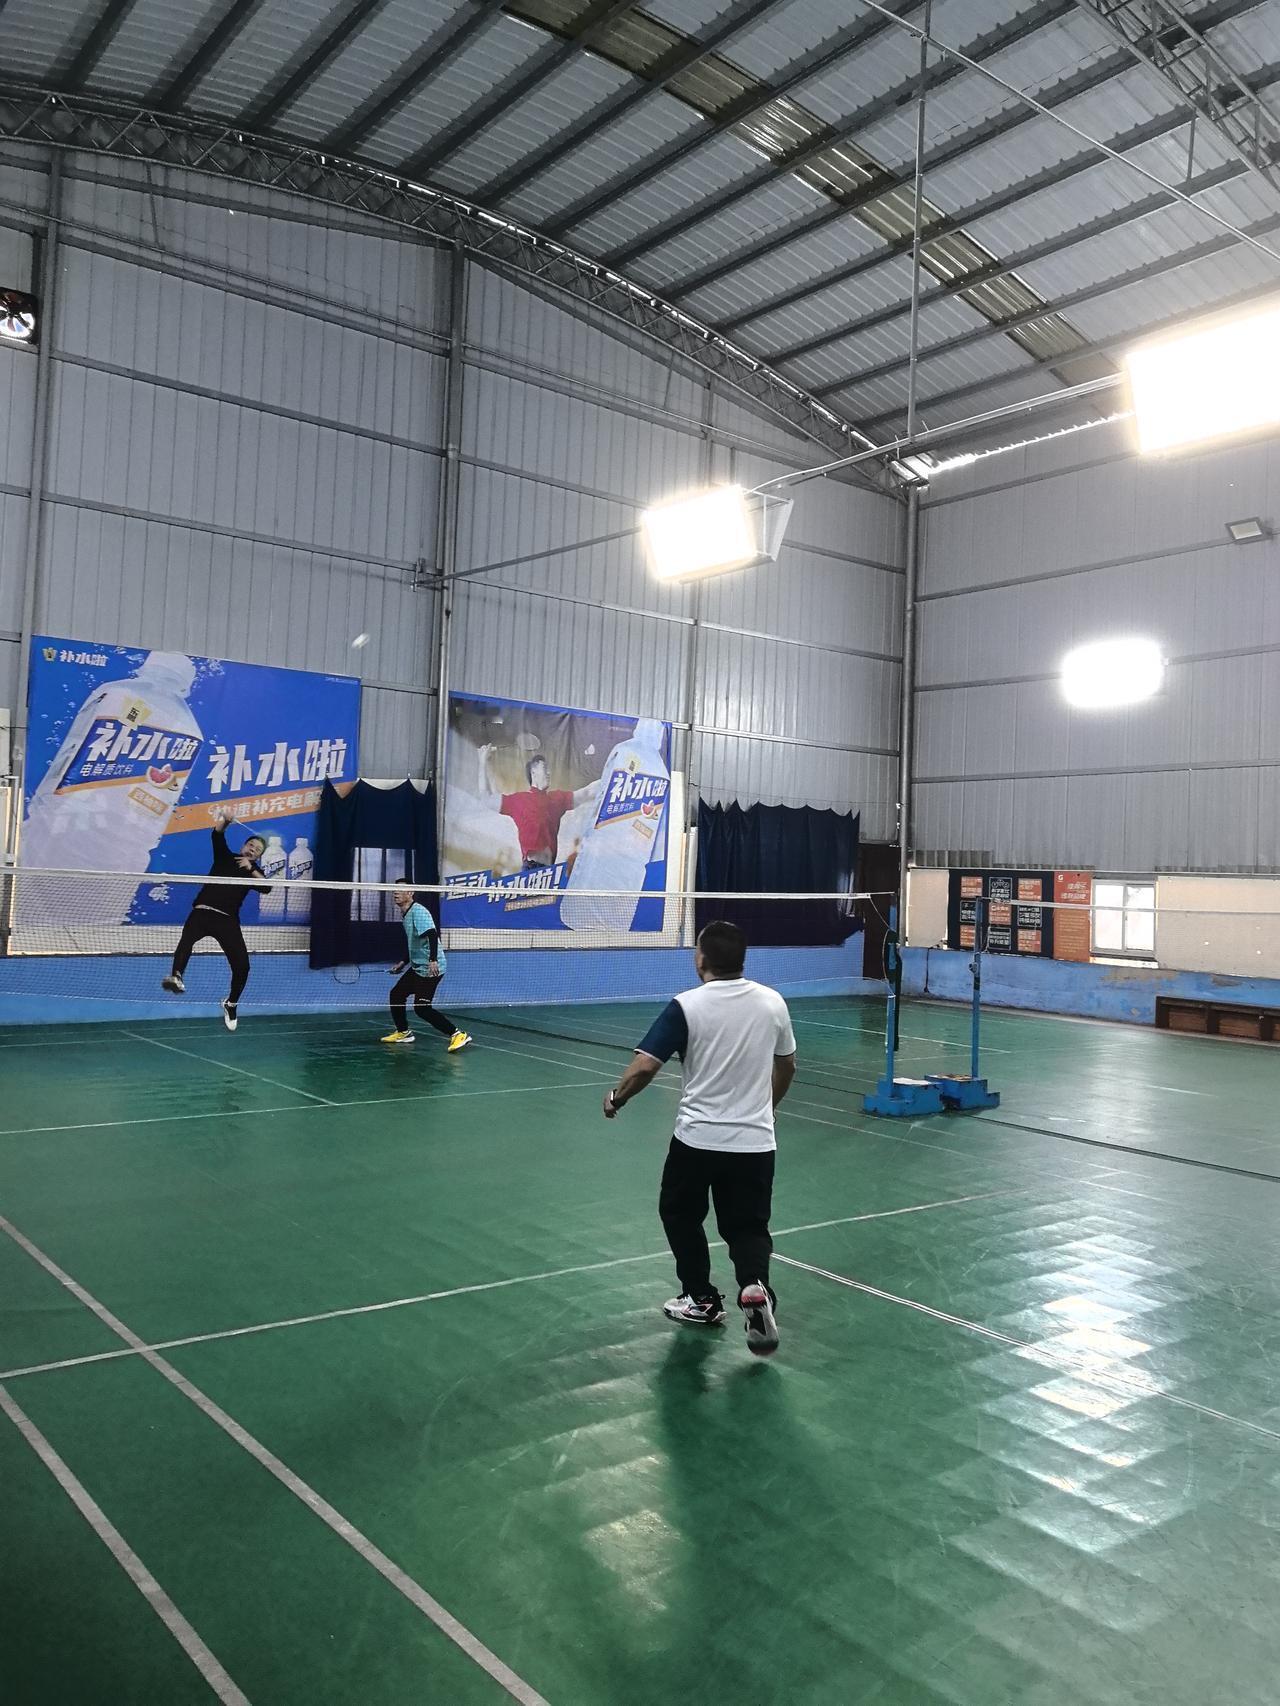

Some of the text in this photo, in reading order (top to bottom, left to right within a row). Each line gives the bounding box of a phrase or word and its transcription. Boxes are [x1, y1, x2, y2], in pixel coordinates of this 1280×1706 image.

[60, 650, 109, 666] 补水啦
[86, 722, 198, 761] 补水啦
[206, 739, 347, 793] 补水啦
[610, 773, 668, 803] 补水啦
